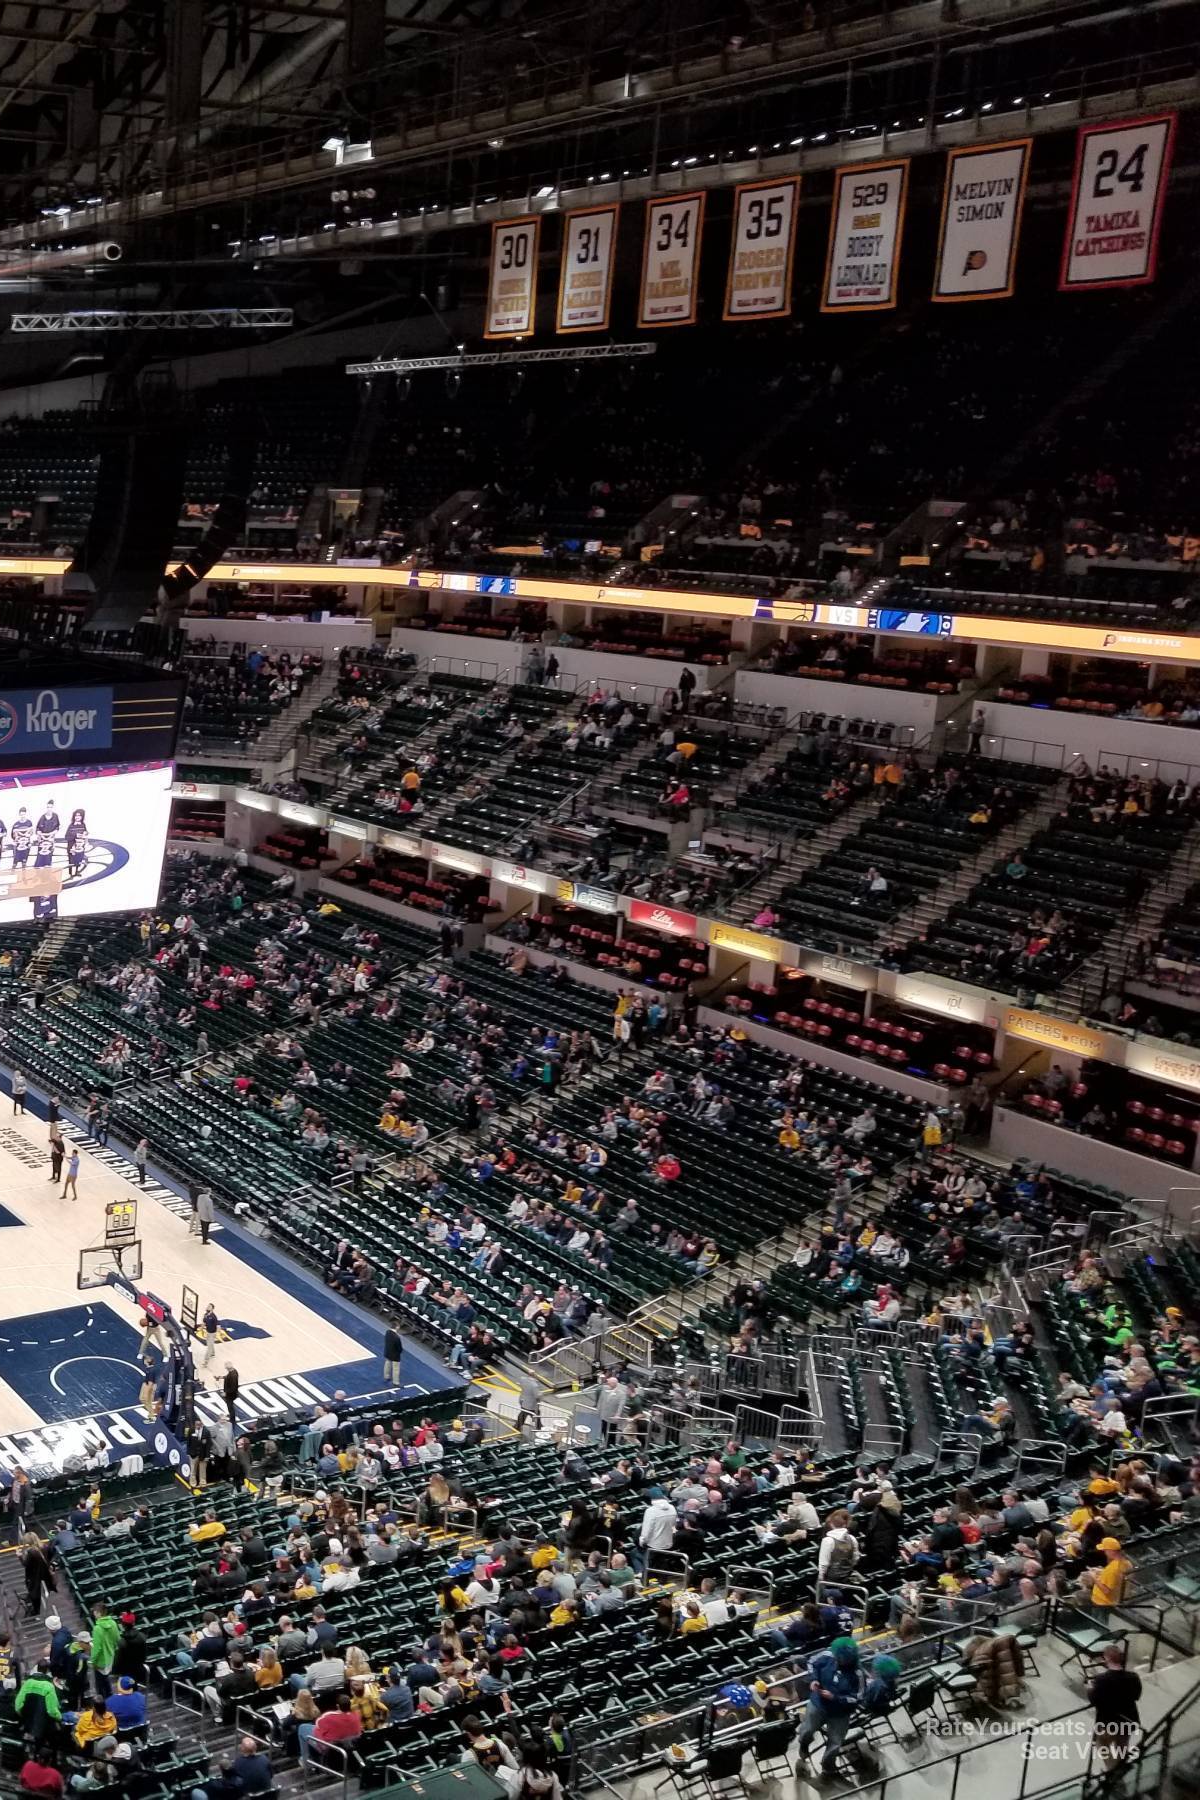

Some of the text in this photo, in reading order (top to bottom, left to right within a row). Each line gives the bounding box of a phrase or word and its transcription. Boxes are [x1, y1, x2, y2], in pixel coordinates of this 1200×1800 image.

[1092, 143, 1150, 198] 24
[852, 182, 888, 208] 529
[954, 177, 1014, 201] MELVIN
[746, 195, 784, 240] 35
[956, 202, 1005, 223] SIMON
[1085, 210, 1140, 233] TAMIKA
[657, 210, 691, 251] 34
[501, 233, 528, 269] 30
[577, 227, 600, 264] 31
[1075, 232, 1146, 257] CATCHINGS
[835, 609, 854, 623] VS
[26, 690, 97, 749] Kroger
[650, 909, 676, 930] Lilly
[946, 994, 963, 1010] ipl
[76, 1137, 162, 1193] BASKETBALL
